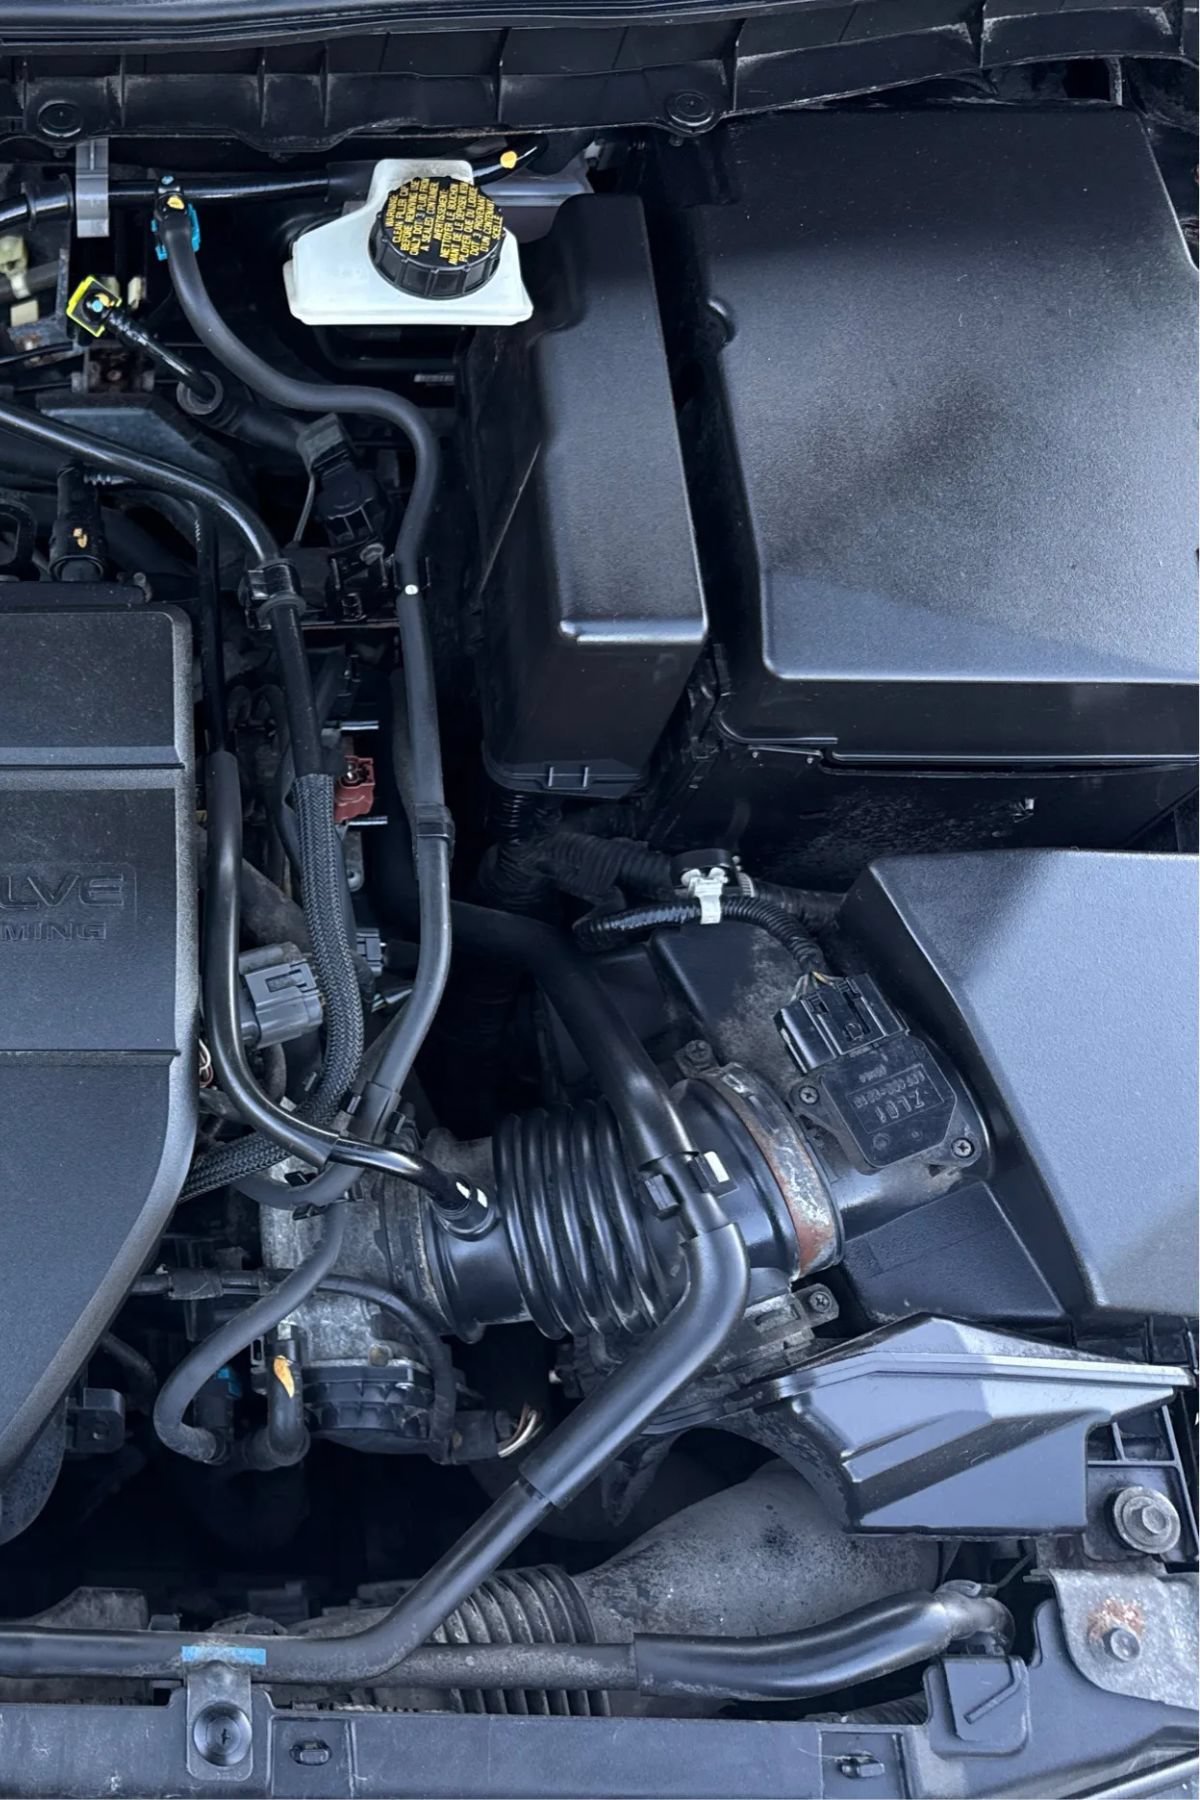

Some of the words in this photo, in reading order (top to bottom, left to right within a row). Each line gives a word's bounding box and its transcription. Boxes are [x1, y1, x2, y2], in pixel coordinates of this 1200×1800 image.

[396, 199, 407, 219] FILLER
[446, 211, 456, 221] LE
[392, 221, 404, 243] CLEAN
[400, 224, 413, 251] BEFORE
[413, 221, 423, 234] DOT
[422, 217, 434, 243] SEALED
[409, 236, 420, 256] ONLY
[440, 222, 454, 258] NETTOYER
[448, 243, 460, 265] AVANT
[454, 222, 464, 231] LE
[470, 240, 480, 256] DOT
